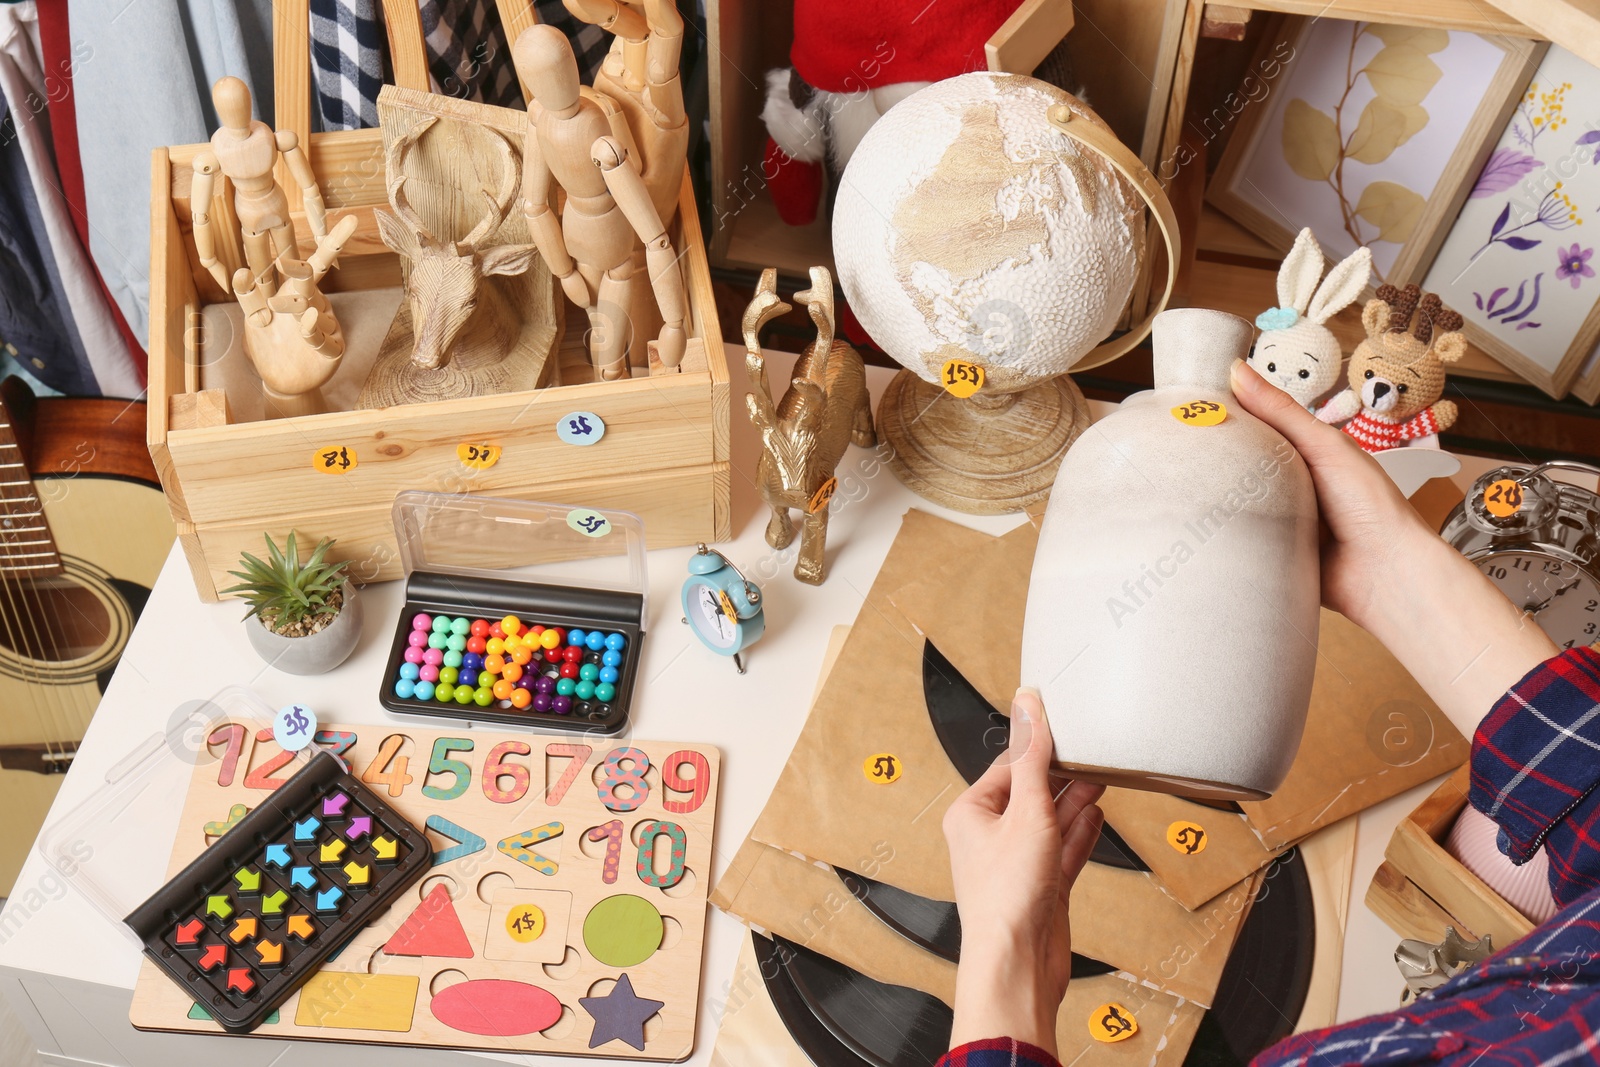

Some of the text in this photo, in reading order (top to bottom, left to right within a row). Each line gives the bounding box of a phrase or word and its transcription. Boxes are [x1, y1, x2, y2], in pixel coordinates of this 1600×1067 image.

[946, 363, 980, 386] 15$
[1180, 400, 1221, 419] 25$
[1487, 565, 1508, 580] 10
[1512, 557, 1532, 572] 11
[1542, 561, 1562, 576] 12
[1584, 599, 1599, 612] 2
[1583, 622, 1597, 635] 3
[283, 706, 310, 736] 3$
[207, 723, 246, 787] 1
[362, 734, 413, 797] 4
[422, 737, 475, 800] 5
[482, 741, 531, 804] 6
[545, 743, 593, 806] 7
[597, 747, 651, 811] 8
[662, 750, 710, 814] 9
[512, 912, 535, 934] 1$
